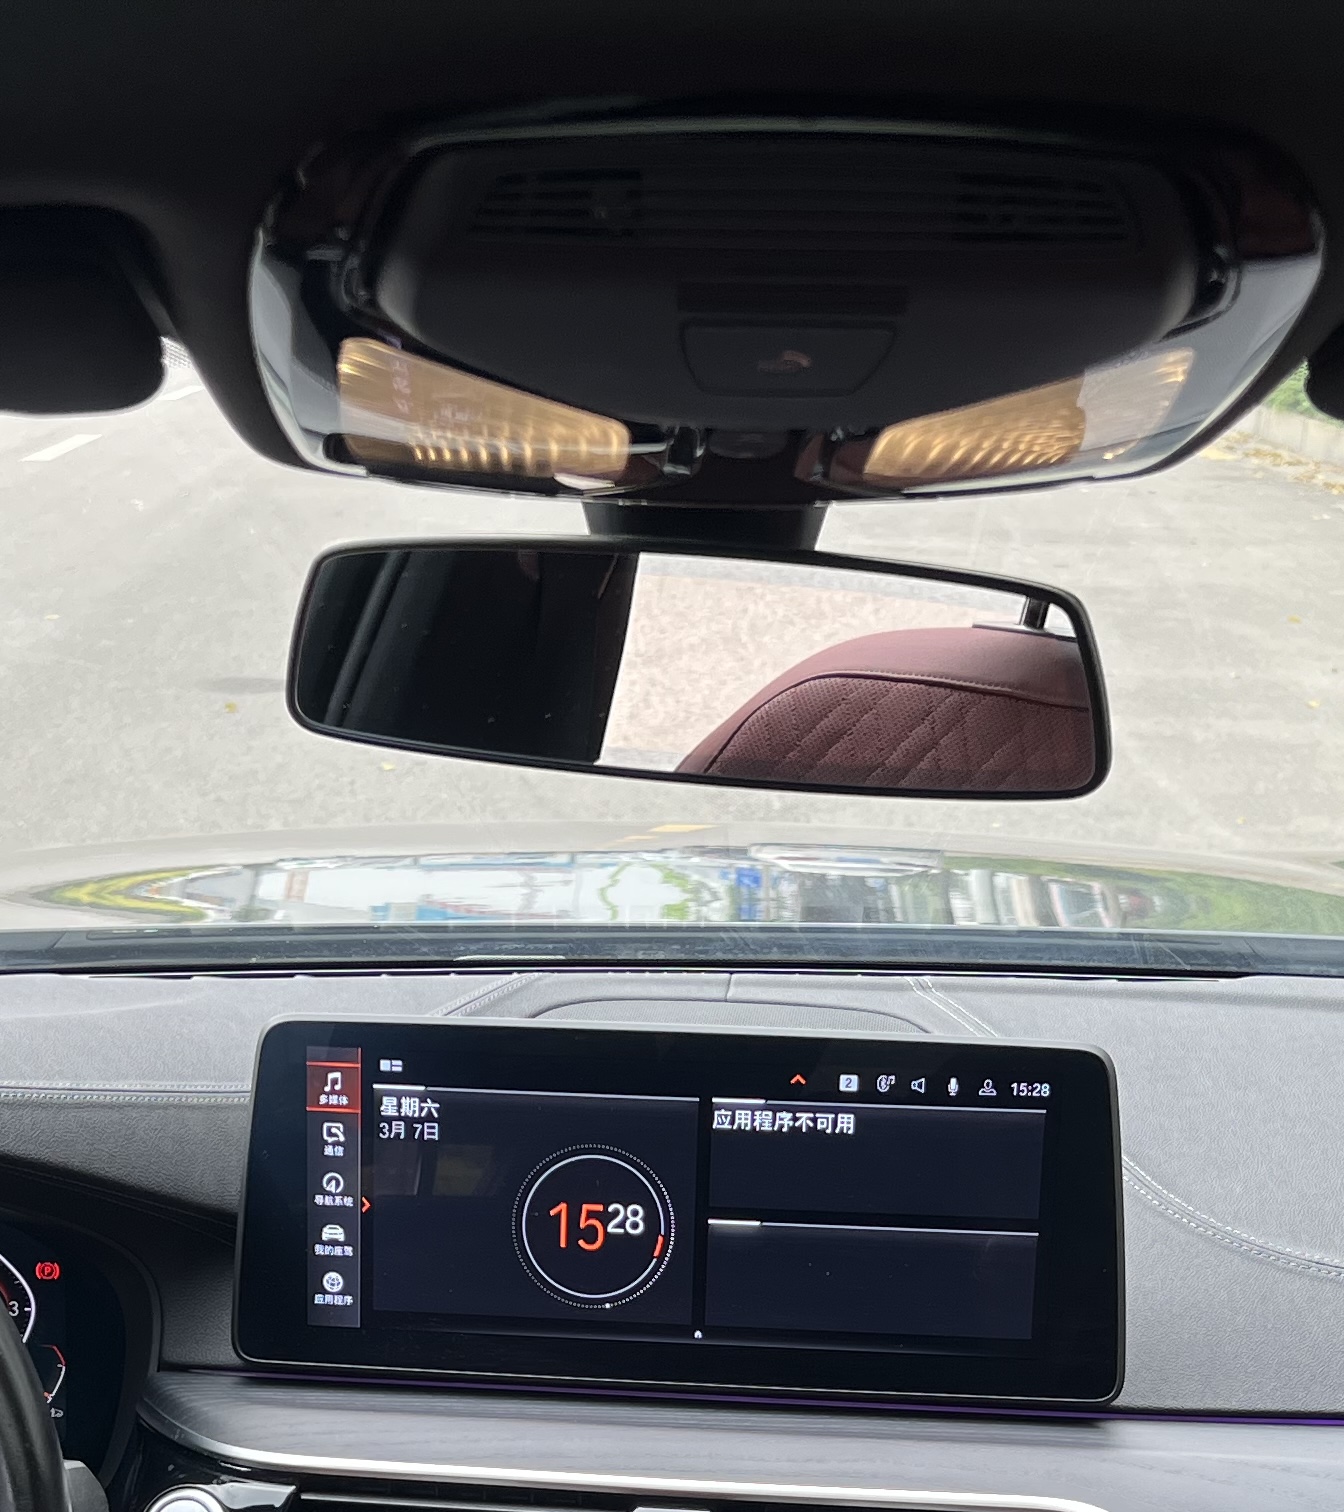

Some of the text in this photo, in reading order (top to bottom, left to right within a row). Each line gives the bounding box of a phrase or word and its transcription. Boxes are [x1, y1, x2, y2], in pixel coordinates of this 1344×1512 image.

[1010, 1082, 1050, 1098] 15:28
[319, 1094, 349, 1106] 多媒体
[380, 1096, 440, 1118] 星期六
[712, 1108, 855, 1135] 应用程序不可用
[379, 1121, 439, 1140] 3月 7日
[323, 1144, 344, 1157] 通信
[314, 1194, 354, 1207] 导航系统
[549, 1201, 644, 1251] 15 28
[314, 1243, 354, 1257] 我的座驾
[314, 1293, 354, 1306] 应用程序
[8, 1301, 20, 1317] 3
